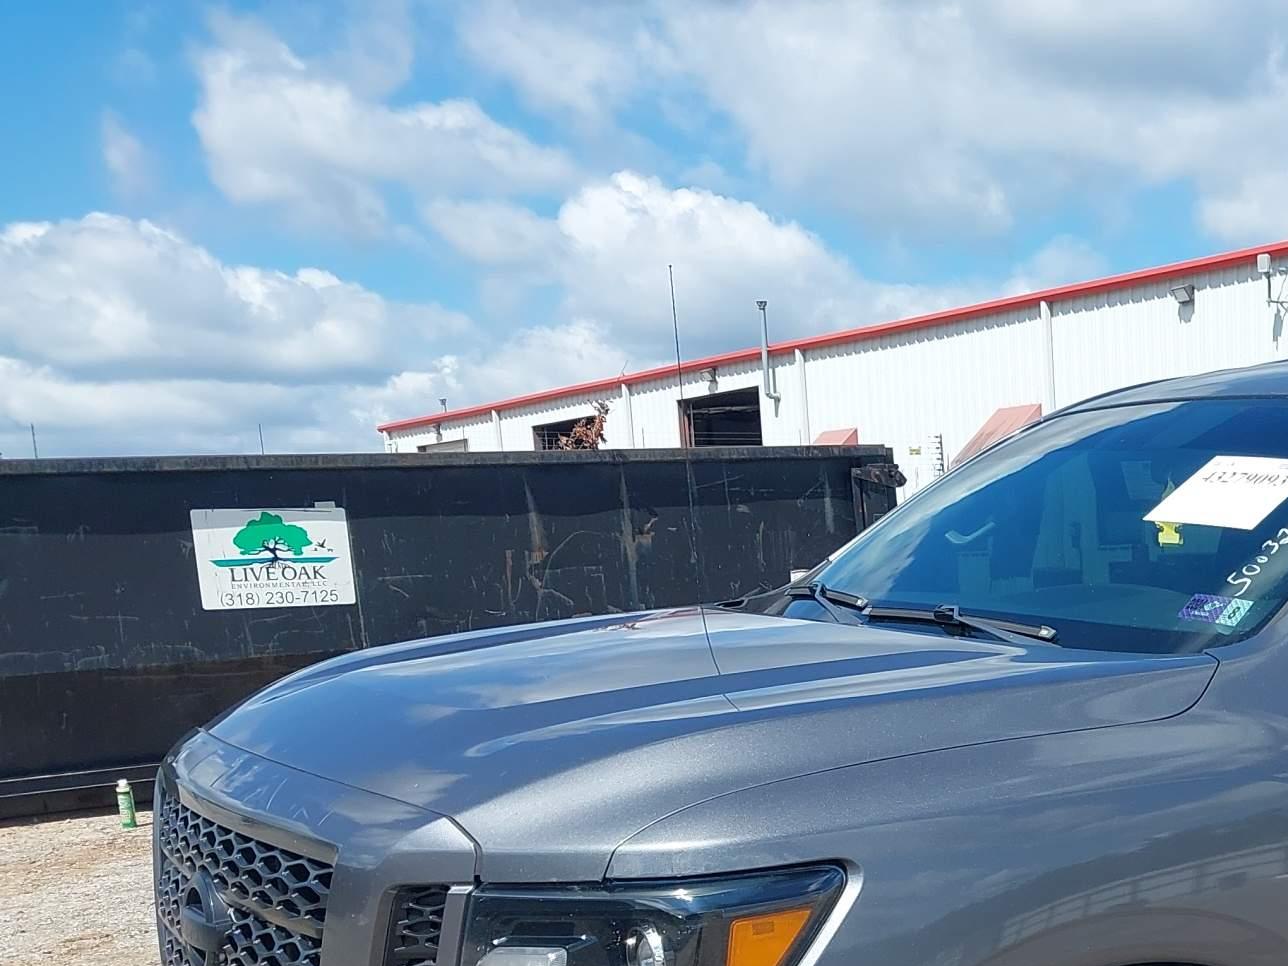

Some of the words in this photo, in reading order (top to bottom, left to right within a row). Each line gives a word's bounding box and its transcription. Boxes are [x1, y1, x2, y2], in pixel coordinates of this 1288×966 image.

[229, 566, 279, 582] LIVE
[281, 565, 328, 581] OAK
[220, 592, 260, 607] (318)
[265, 589, 339, 605] 230-7125
